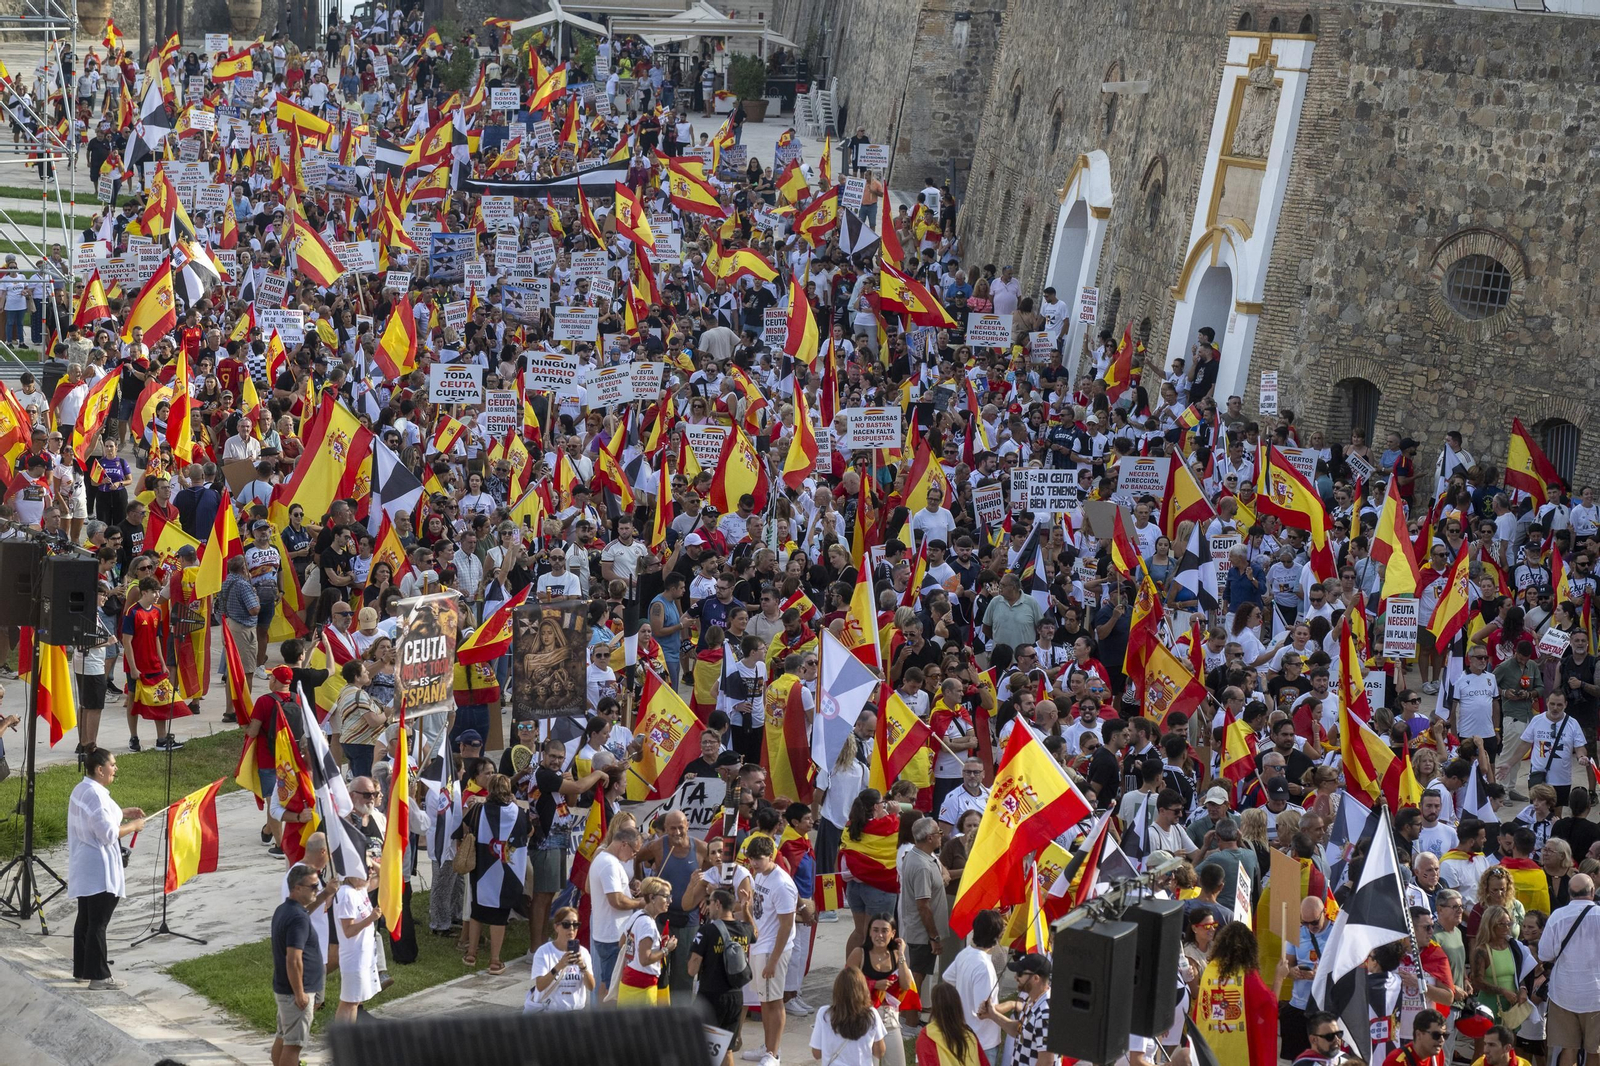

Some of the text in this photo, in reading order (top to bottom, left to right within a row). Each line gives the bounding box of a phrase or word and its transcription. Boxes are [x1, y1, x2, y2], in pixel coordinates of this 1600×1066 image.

[265, 277, 285, 287] CEUTA
[593, 282, 612, 292] CEUTA
[264, 284, 283, 294] EXIGE
[531, 359, 576, 370] NINGÚN
[532, 367, 575, 378] BARRIO
[595, 371, 629, 383] ESPAÑOLIDAD
[222, 373, 230, 388] 9
[534, 375, 572, 385] ATRÁS
[488, 415, 516, 423] ESPAÑA
[1351, 457, 1369, 475] CEUTA
[1014, 472, 1022, 480] NO
[1038, 473, 1073, 483] EN CEUTA
[1031, 486, 1077, 496] LOS TENEMOS
[976, 492, 1001, 504] NINGÚN
[976, 498, 1001, 512] BARRIO
[1050, 499, 1078, 509] PUESTOS
[252, 550, 277, 559] CEUTA
[1392, 605, 1414, 614] CEUTA
[1388, 617, 1416, 626] NECESITA
[404, 635, 447, 665] CEUTA
[403, 659, 449, 680] NO SE TOCA
[420, 677, 430, 686] ES
[401, 681, 447, 708] ESPAÑA
[518, 702, 532, 713] CEUTA
